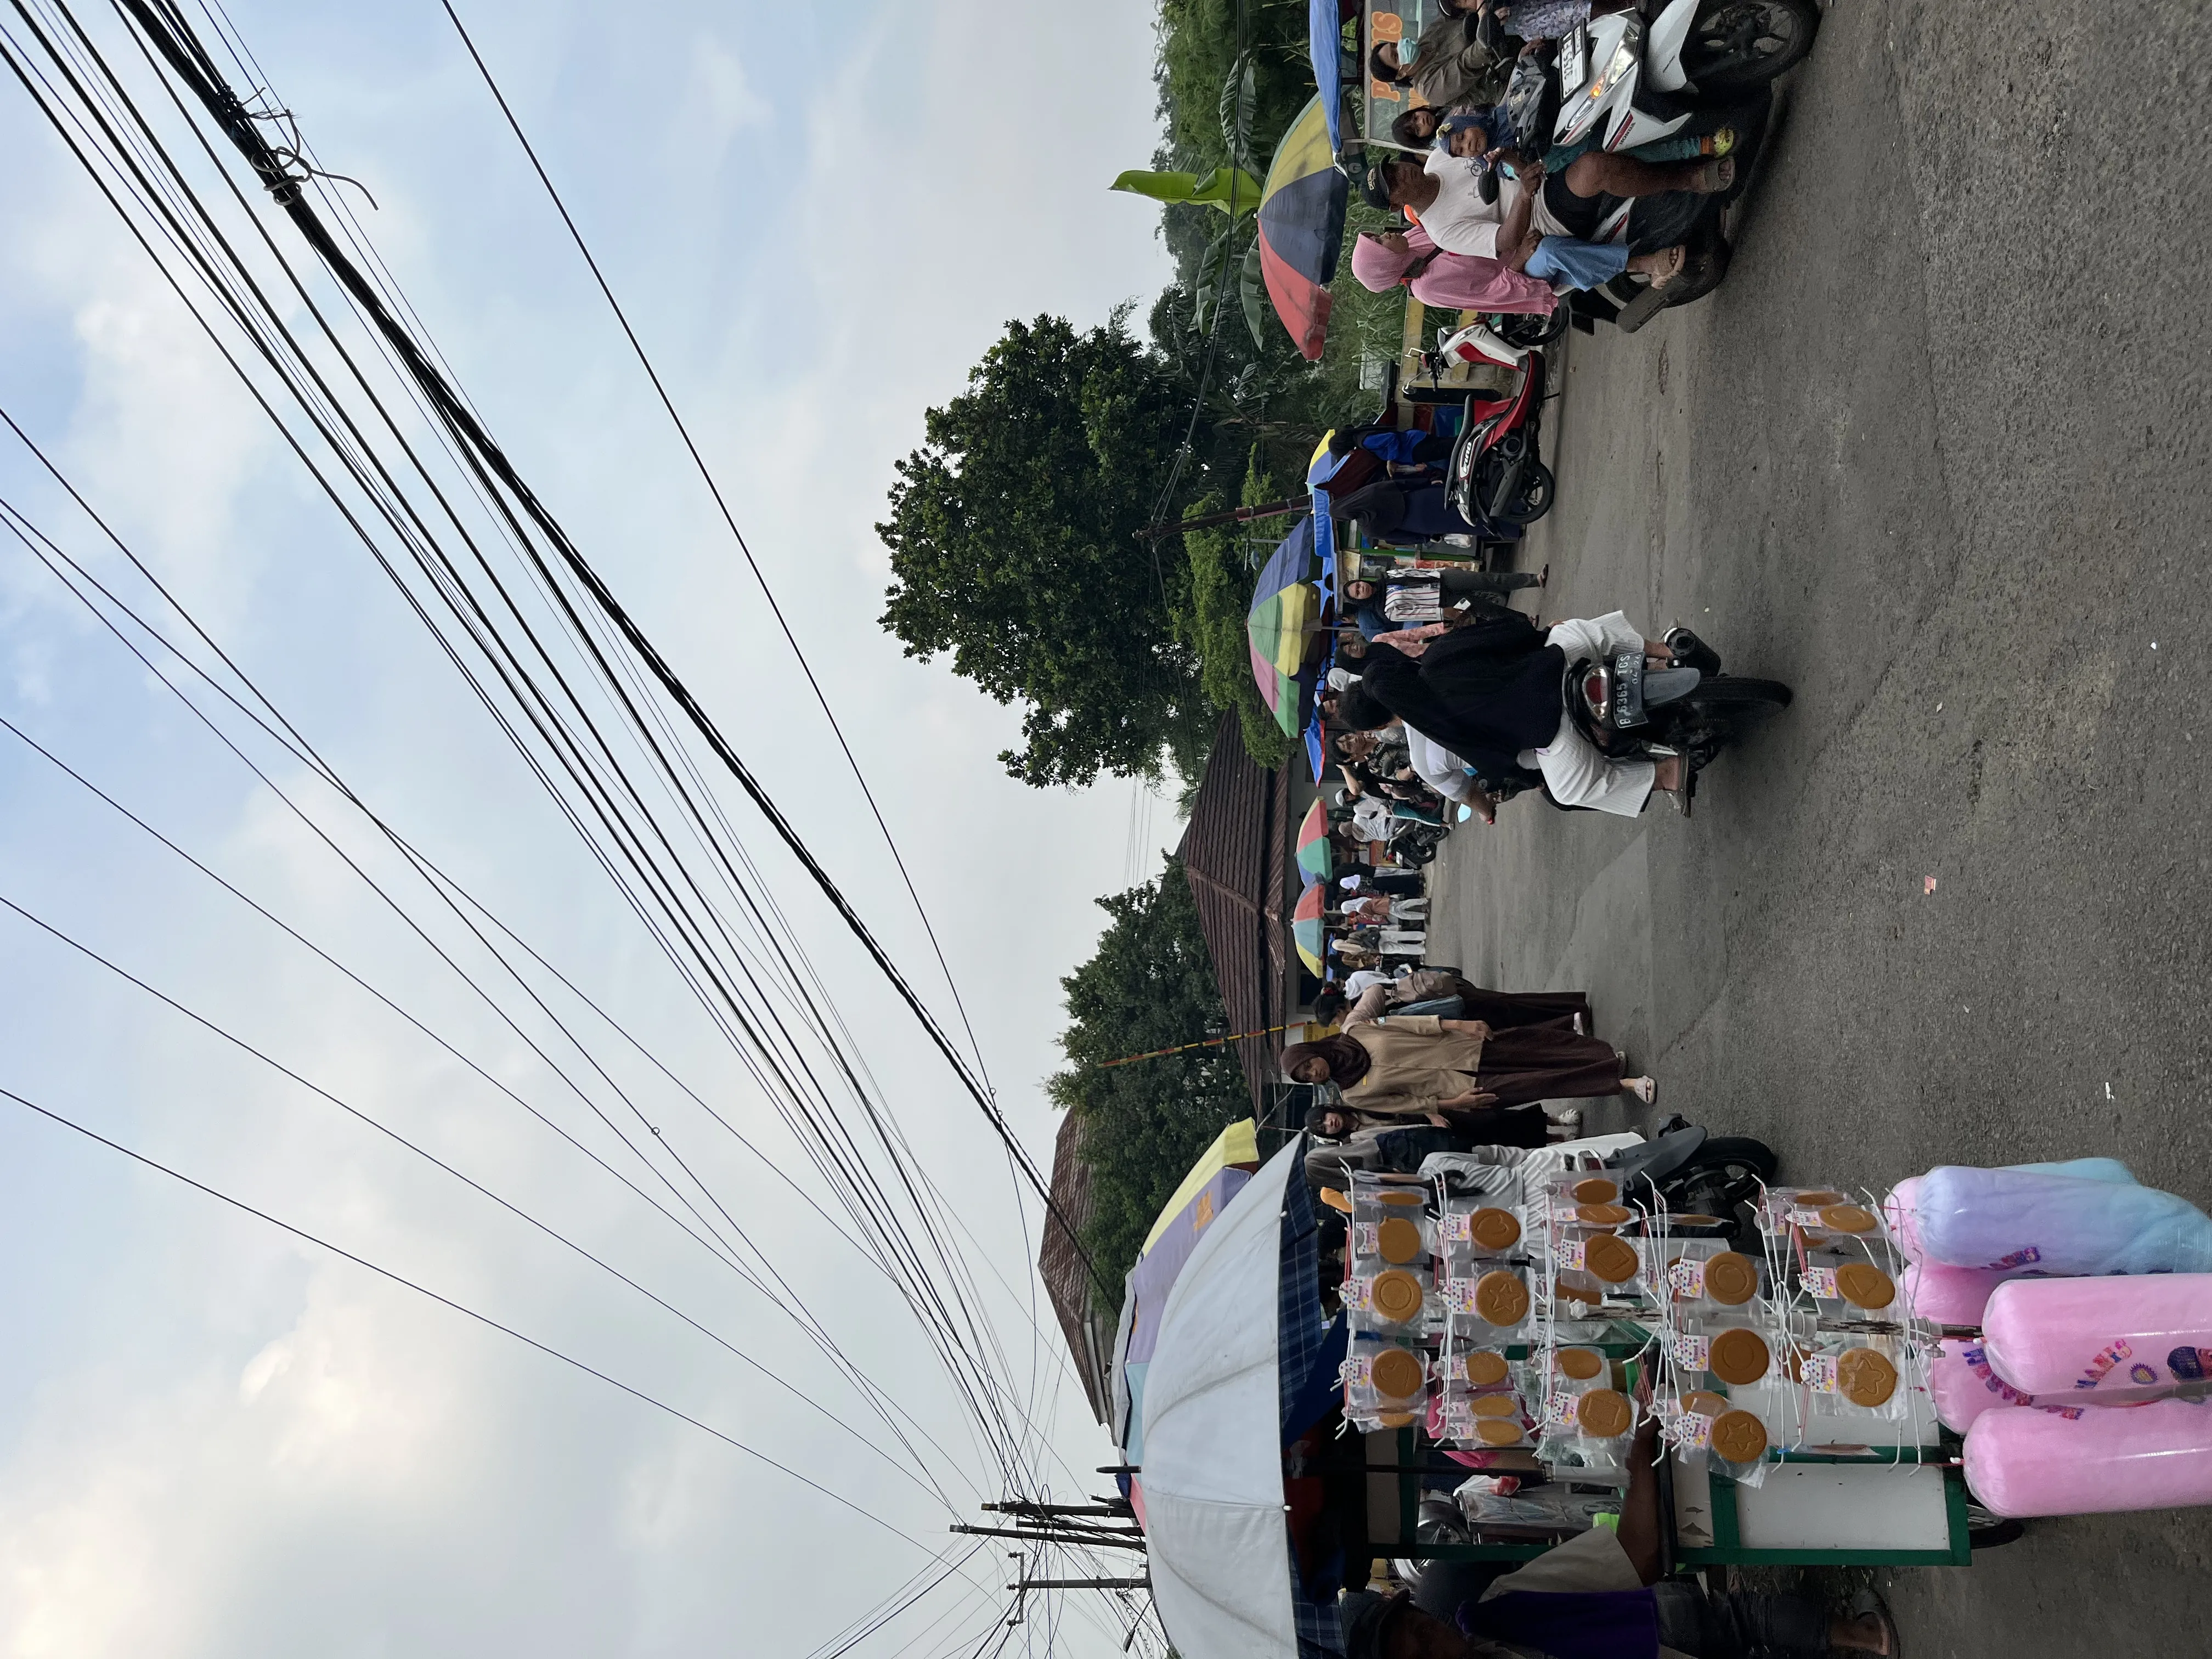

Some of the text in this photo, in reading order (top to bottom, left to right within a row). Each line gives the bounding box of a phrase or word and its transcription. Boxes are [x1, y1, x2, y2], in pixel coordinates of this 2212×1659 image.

[1564, 51, 1573, 80] 3255
[1619, 122, 1636, 145] HONDA
[1616, 682, 1628, 713] 6365
